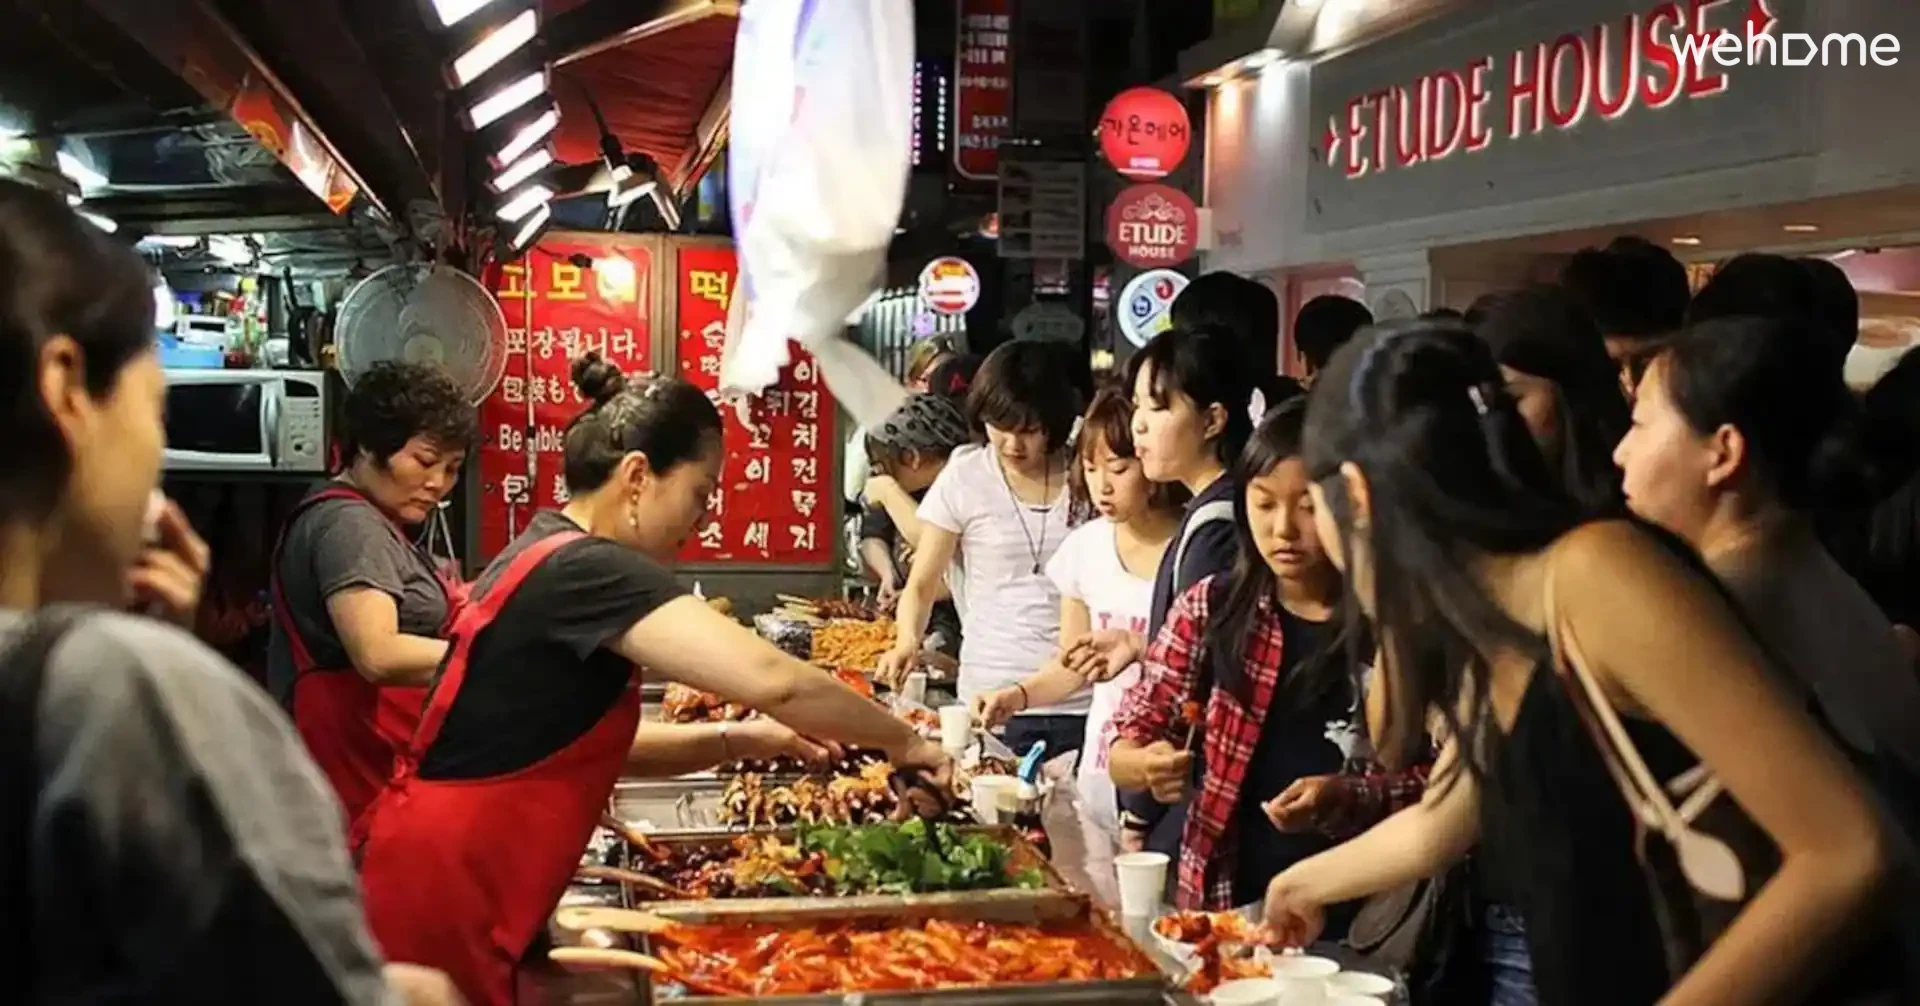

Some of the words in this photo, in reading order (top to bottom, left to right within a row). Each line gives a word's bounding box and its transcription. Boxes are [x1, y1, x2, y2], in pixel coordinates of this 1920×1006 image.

[1345, 57, 1494, 179] ETUDE
[1506, 0, 1730, 140] HOUSE
[1119, 222, 1188, 245] ETUDE
[1128, 245, 1176, 259] HOUSE
[499, 424, 523, 452] Be
